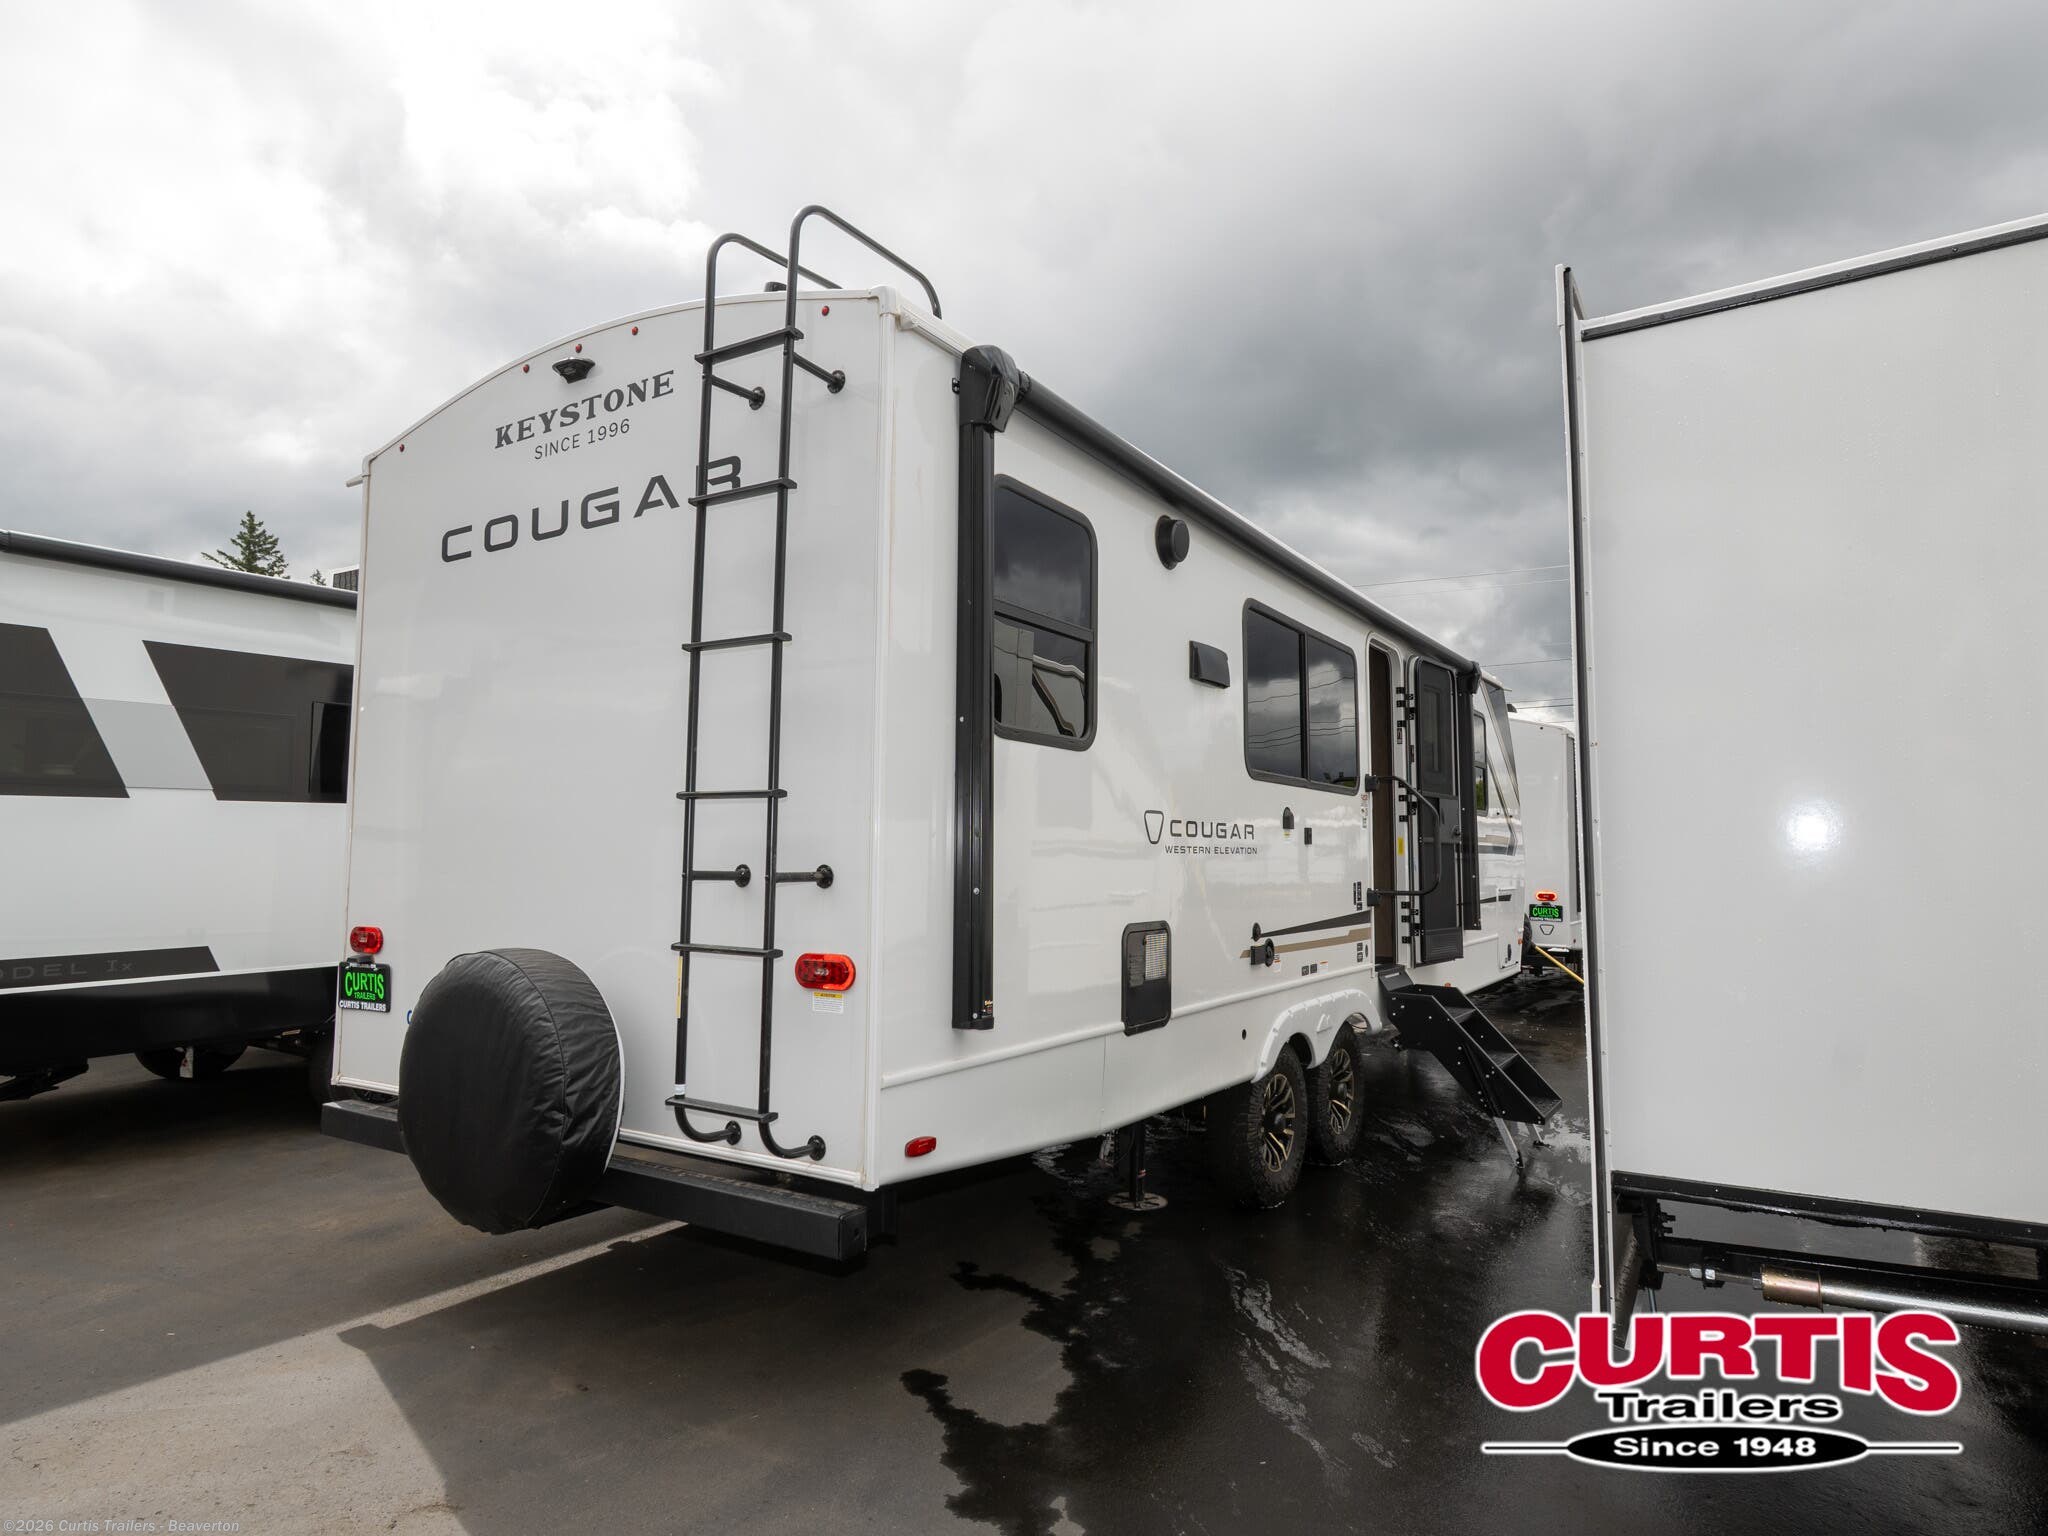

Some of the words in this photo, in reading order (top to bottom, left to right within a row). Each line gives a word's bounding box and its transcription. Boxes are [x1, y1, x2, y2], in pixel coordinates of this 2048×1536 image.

[494, 369, 675, 450] KEYSTONE
[534, 433, 581, 460] SINCE
[587, 418, 631, 444] 1996
[441, 455, 742, 563] COUGAR
[1169, 819, 1255, 840] COUGAR
[1165, 844, 1211, 855] WESTERN
[1214, 845, 1258, 855] ELEVATION
[1533, 907, 1559, 917] CURTIS
[0, 963, 88, 980] DEL
[345, 971, 384, 999] CURTIS
[354, 992, 376, 1000] TRAILERS
[339, 1000, 360, 1009] CURTIS
[361, 1001, 386, 1012] TRAILERS
